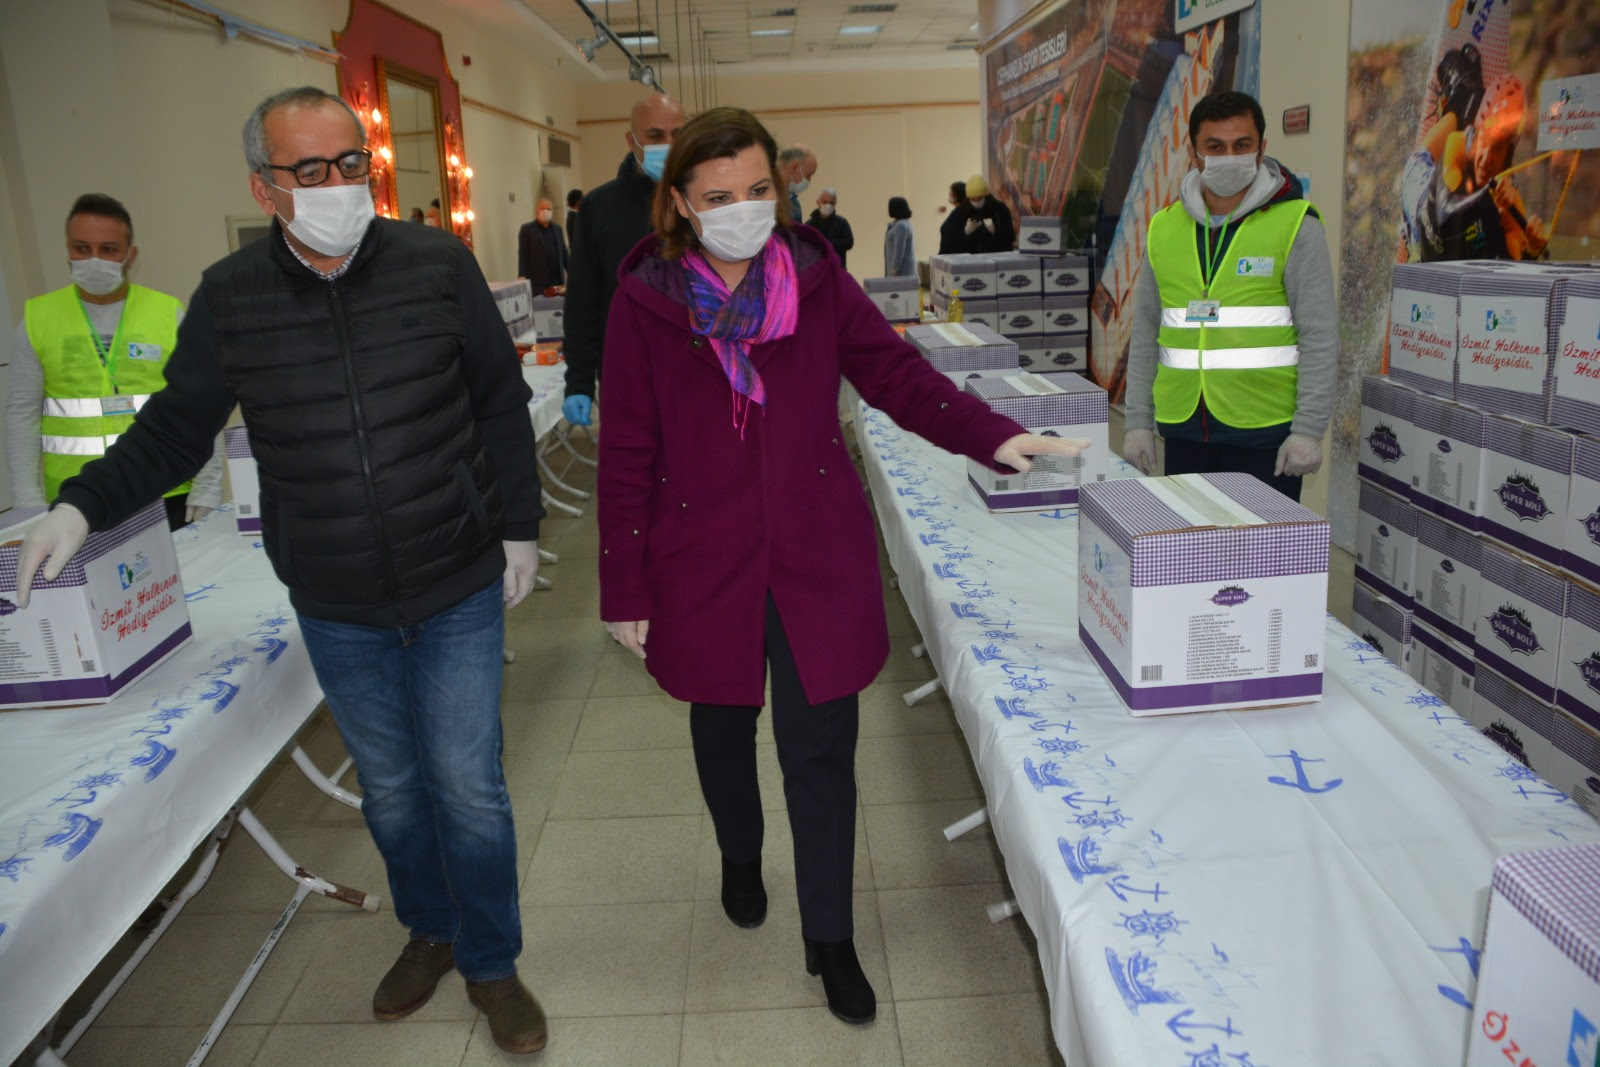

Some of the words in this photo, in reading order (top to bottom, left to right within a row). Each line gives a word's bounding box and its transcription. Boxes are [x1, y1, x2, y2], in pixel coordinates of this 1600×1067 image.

[1393, 323, 1415, 339] İzmit
[1461, 334, 1491, 351] İzmit
[1494, 339, 1541, 355] Halkının
[101, 608, 133, 631] İzmit
[137, 574, 178, 608] Halkının
